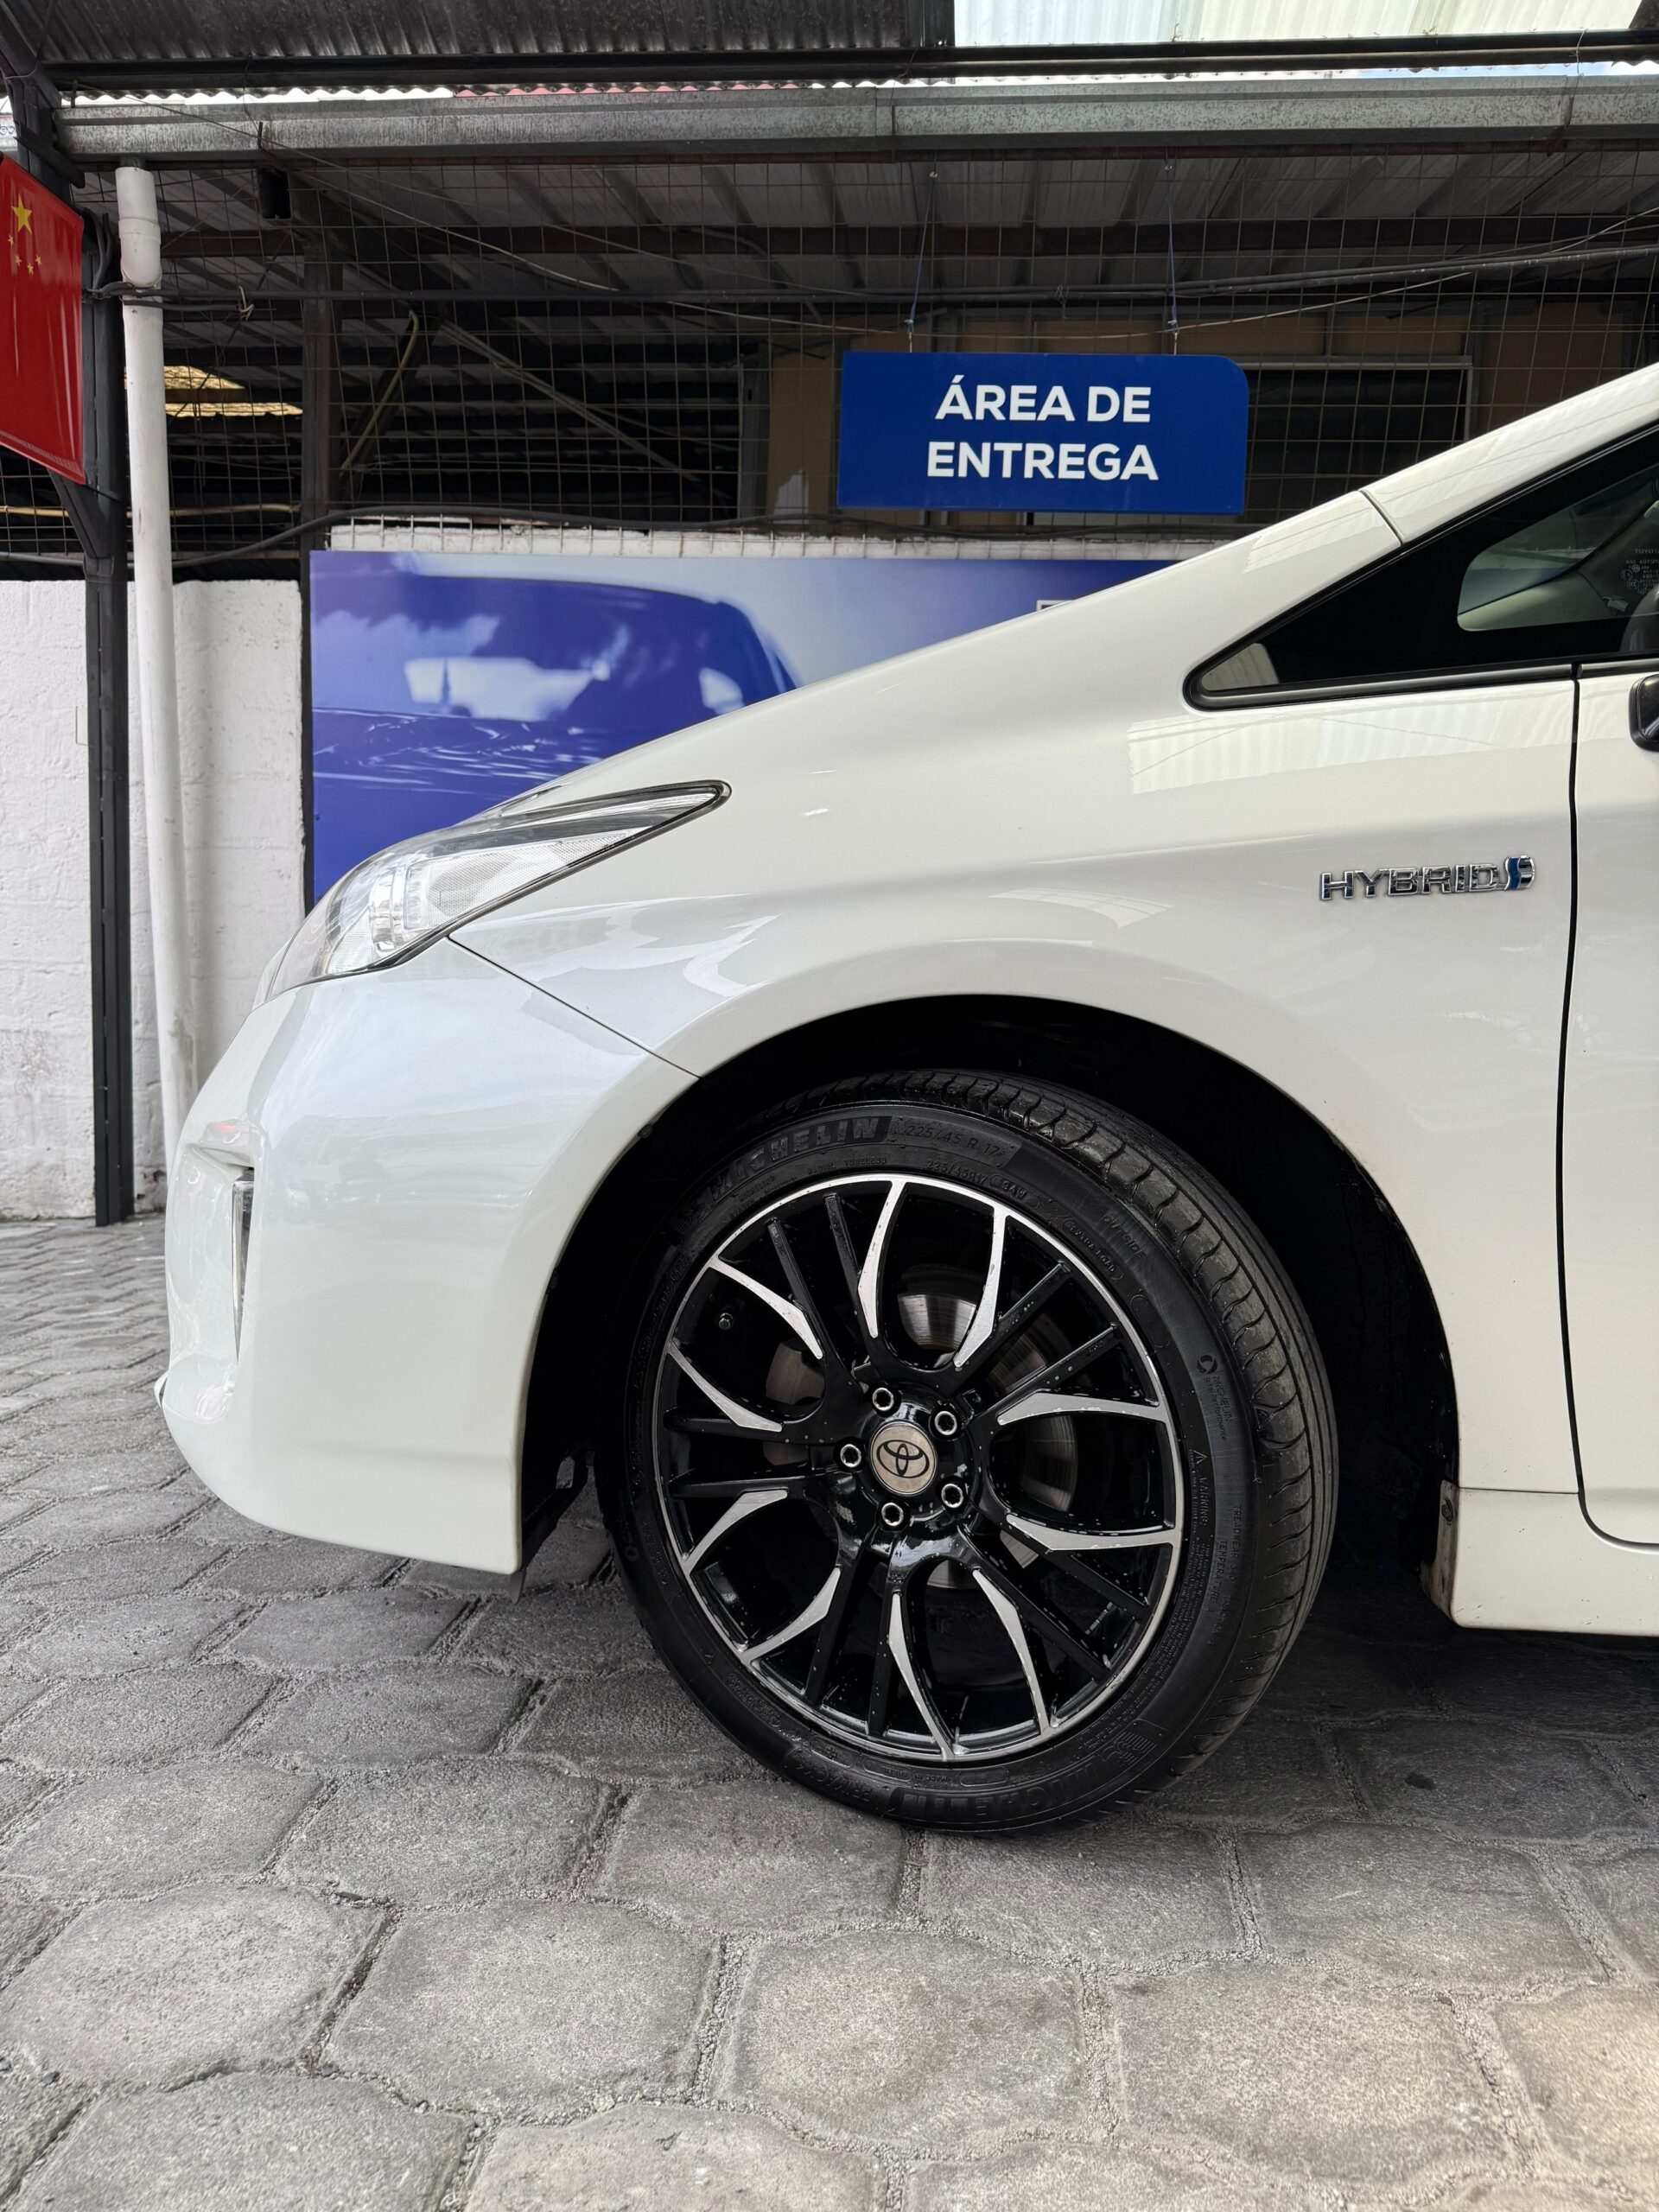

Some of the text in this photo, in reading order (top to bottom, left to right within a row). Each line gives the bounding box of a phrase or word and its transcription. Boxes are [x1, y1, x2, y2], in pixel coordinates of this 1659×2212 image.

[935, 374, 1152, 423] ÁREA DE
[927, 442, 1159, 480] ENTREGA
[1320, 862, 1500, 900] HYBRID
[710, 1118, 880, 1194] MICHELIN
[906, 1125, 963, 1147] 225/45
[966, 1138, 979, 1150] R
[983, 1143, 1001, 1156] 17
[1230, 1503, 1242, 1559] TREADWEAR
